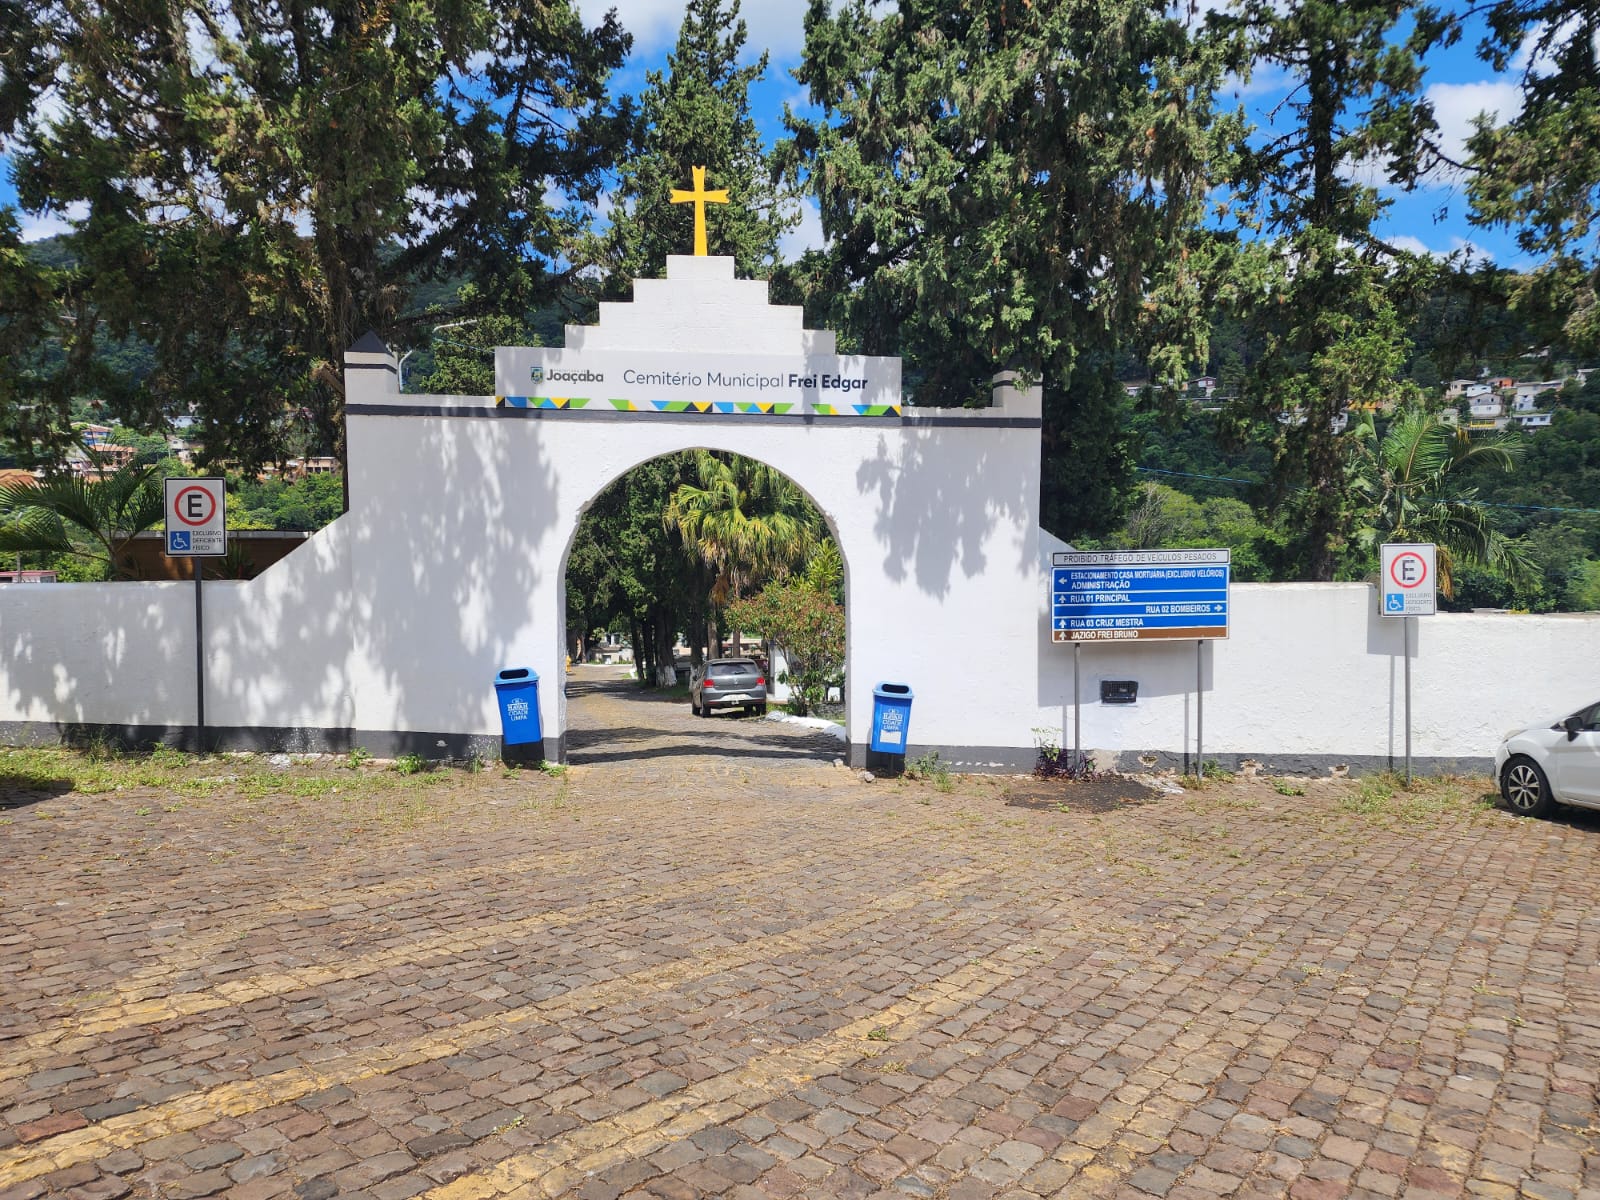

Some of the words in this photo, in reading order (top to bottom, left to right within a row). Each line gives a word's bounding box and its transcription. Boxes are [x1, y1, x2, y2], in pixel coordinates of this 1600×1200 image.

[546, 369, 604, 384] Joaçaba
[623, 369, 702, 387] Cemitério
[707, 372, 784, 391] Municipal
[788, 374, 817, 388] Frei
[821, 375, 868, 392] Edgar
[187, 494, 203, 517] E
[1063, 555, 1098, 563] PROIBIDO
[1136, 553, 1146, 562] DE
[1147, 552, 1181, 561] VEÍCULOS
[1184, 552, 1217, 561] PESADOS
[1070, 571, 1118, 580] ESTACIONAMENTO
[1119, 571, 1134, 579] CASA
[1134, 569, 1166, 579] MORTUÁRIA
[1165, 570, 1197, 580] (EXCLUSIVO
[1196, 568, 1225, 579] VELÓRIOS)
[1402, 559, 1416, 581] E
[1071, 579, 1131, 590] ADMINISTRAÇÃO
[1070, 595, 1086, 603] RUA
[1086, 594, 1094, 602] 01
[1095, 594, 1131, 602] PRINCIPAL
[1145, 605, 1160, 614] RUA
[1161, 605, 1170, 613] 02
[1170, 604, 1211, 613] BOMBEIROS
[1070, 619, 1086, 627] RUA
[1086, 619, 1095, 627] 03
[1095, 619, 1115, 627] CRUZ
[1115, 618, 1144, 627] MESTRA
[1070, 631, 1097, 640] JAZIGO
[1097, 631, 1113, 639] FREI
[1113, 630, 1139, 639] BRUNO
